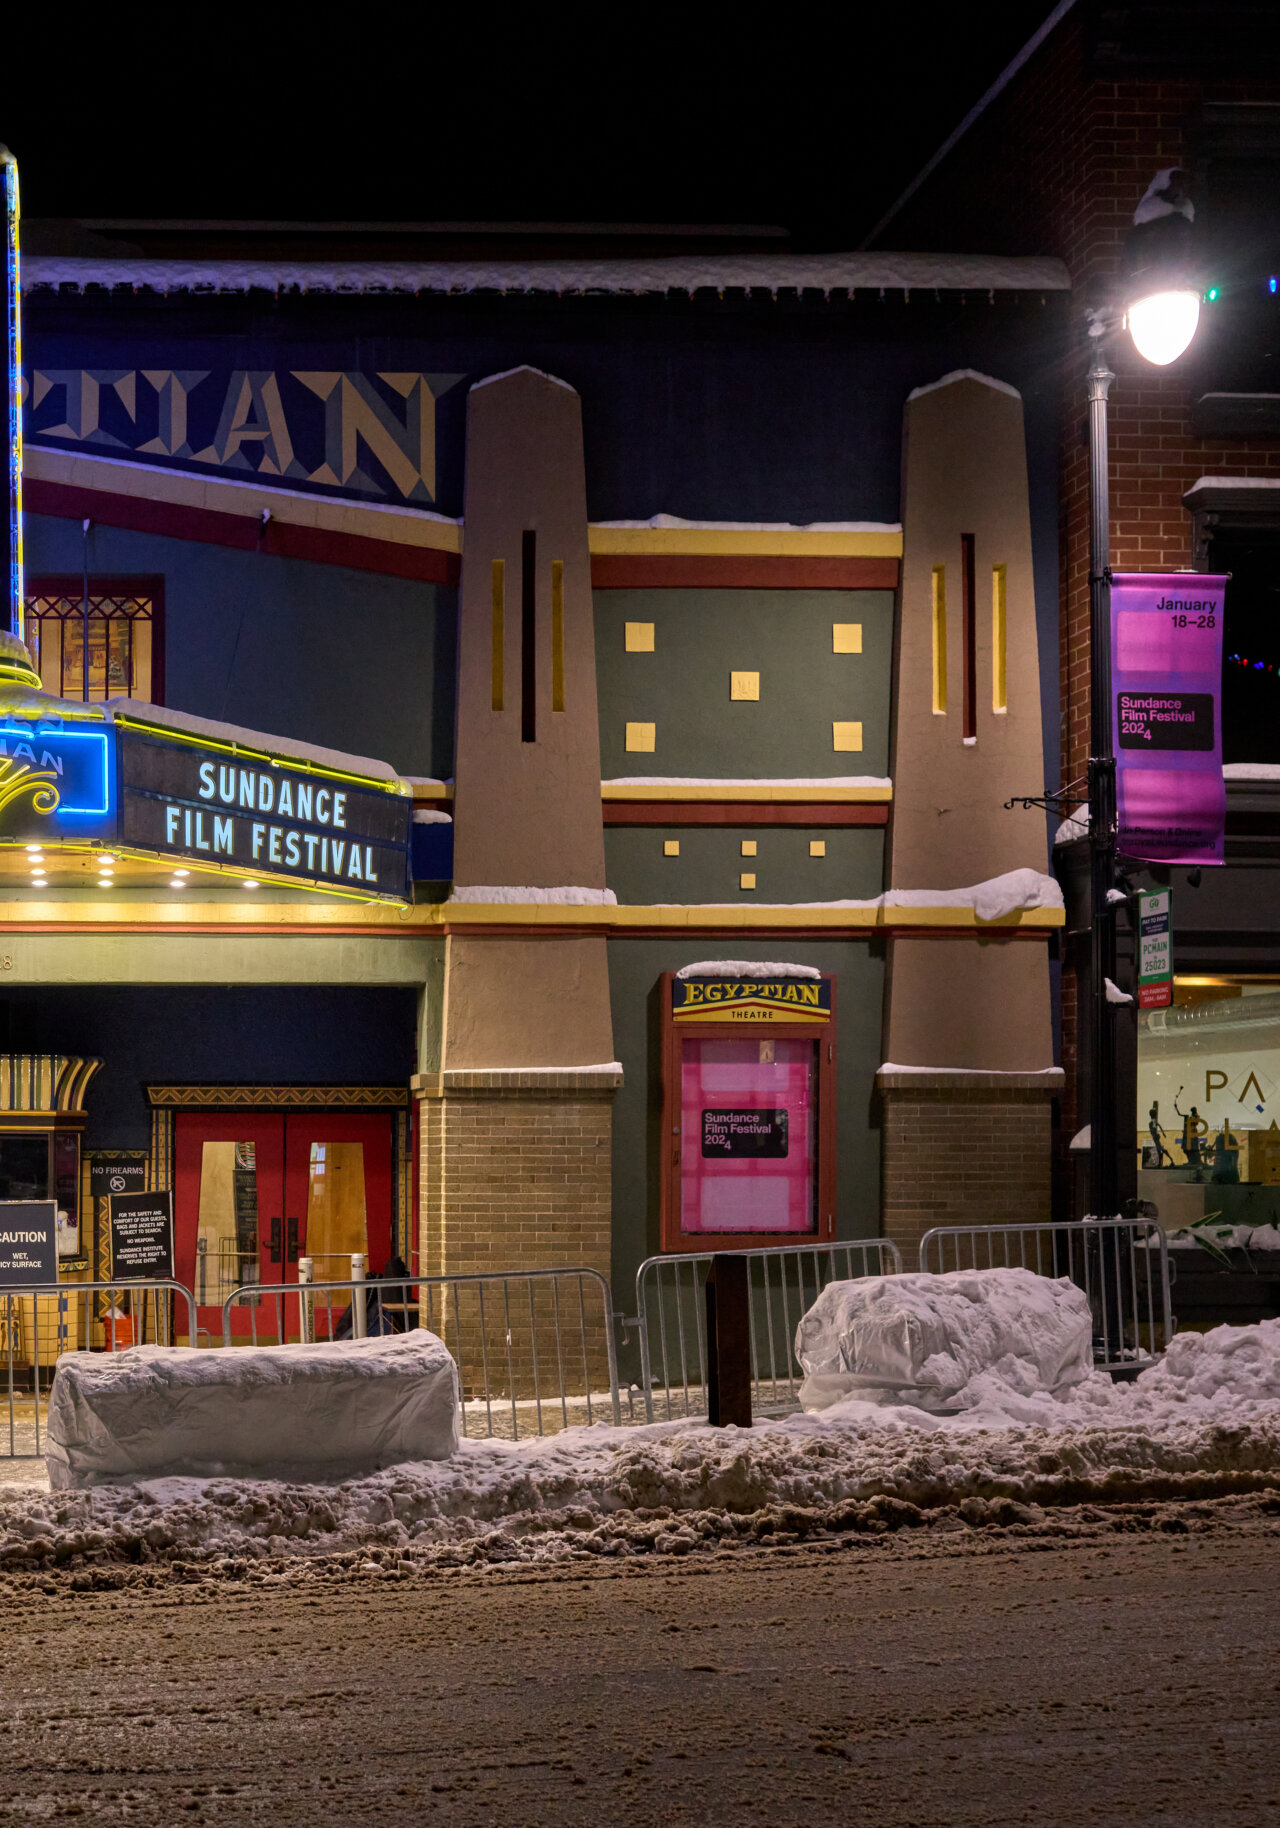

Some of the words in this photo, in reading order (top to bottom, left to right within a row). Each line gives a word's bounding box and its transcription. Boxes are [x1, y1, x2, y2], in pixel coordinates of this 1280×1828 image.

[1156, 597, 1216, 614] January
[1121, 696, 1182, 709] Sundance
[1121, 709, 1147, 721] Film
[1149, 710, 1196, 722] Festival
[1121, 722, 1152, 741] 2024
[198, 761, 347, 829] SUNDANCE
[166, 805, 234, 856] FILM
[252, 822, 379, 883] FESTIVAL
[1143, 941, 1168, 954] PCMAIN
[1145, 958, 1166, 972] 25023
[683, 982, 822, 1005] EGYPTIAN
[731, 1010, 774, 1019] THEATRE
[704, 1112, 760, 1123] Sundance
[704, 1123, 728, 1134] Film
[730, 1123, 772, 1134] Festival
[704, 1134, 731, 1150] 2024
[12, 1252, 29, 1260] WET,
[0, 1260, 11, 1268] ICY
[11, 1260, 43, 1268] SURFACE
